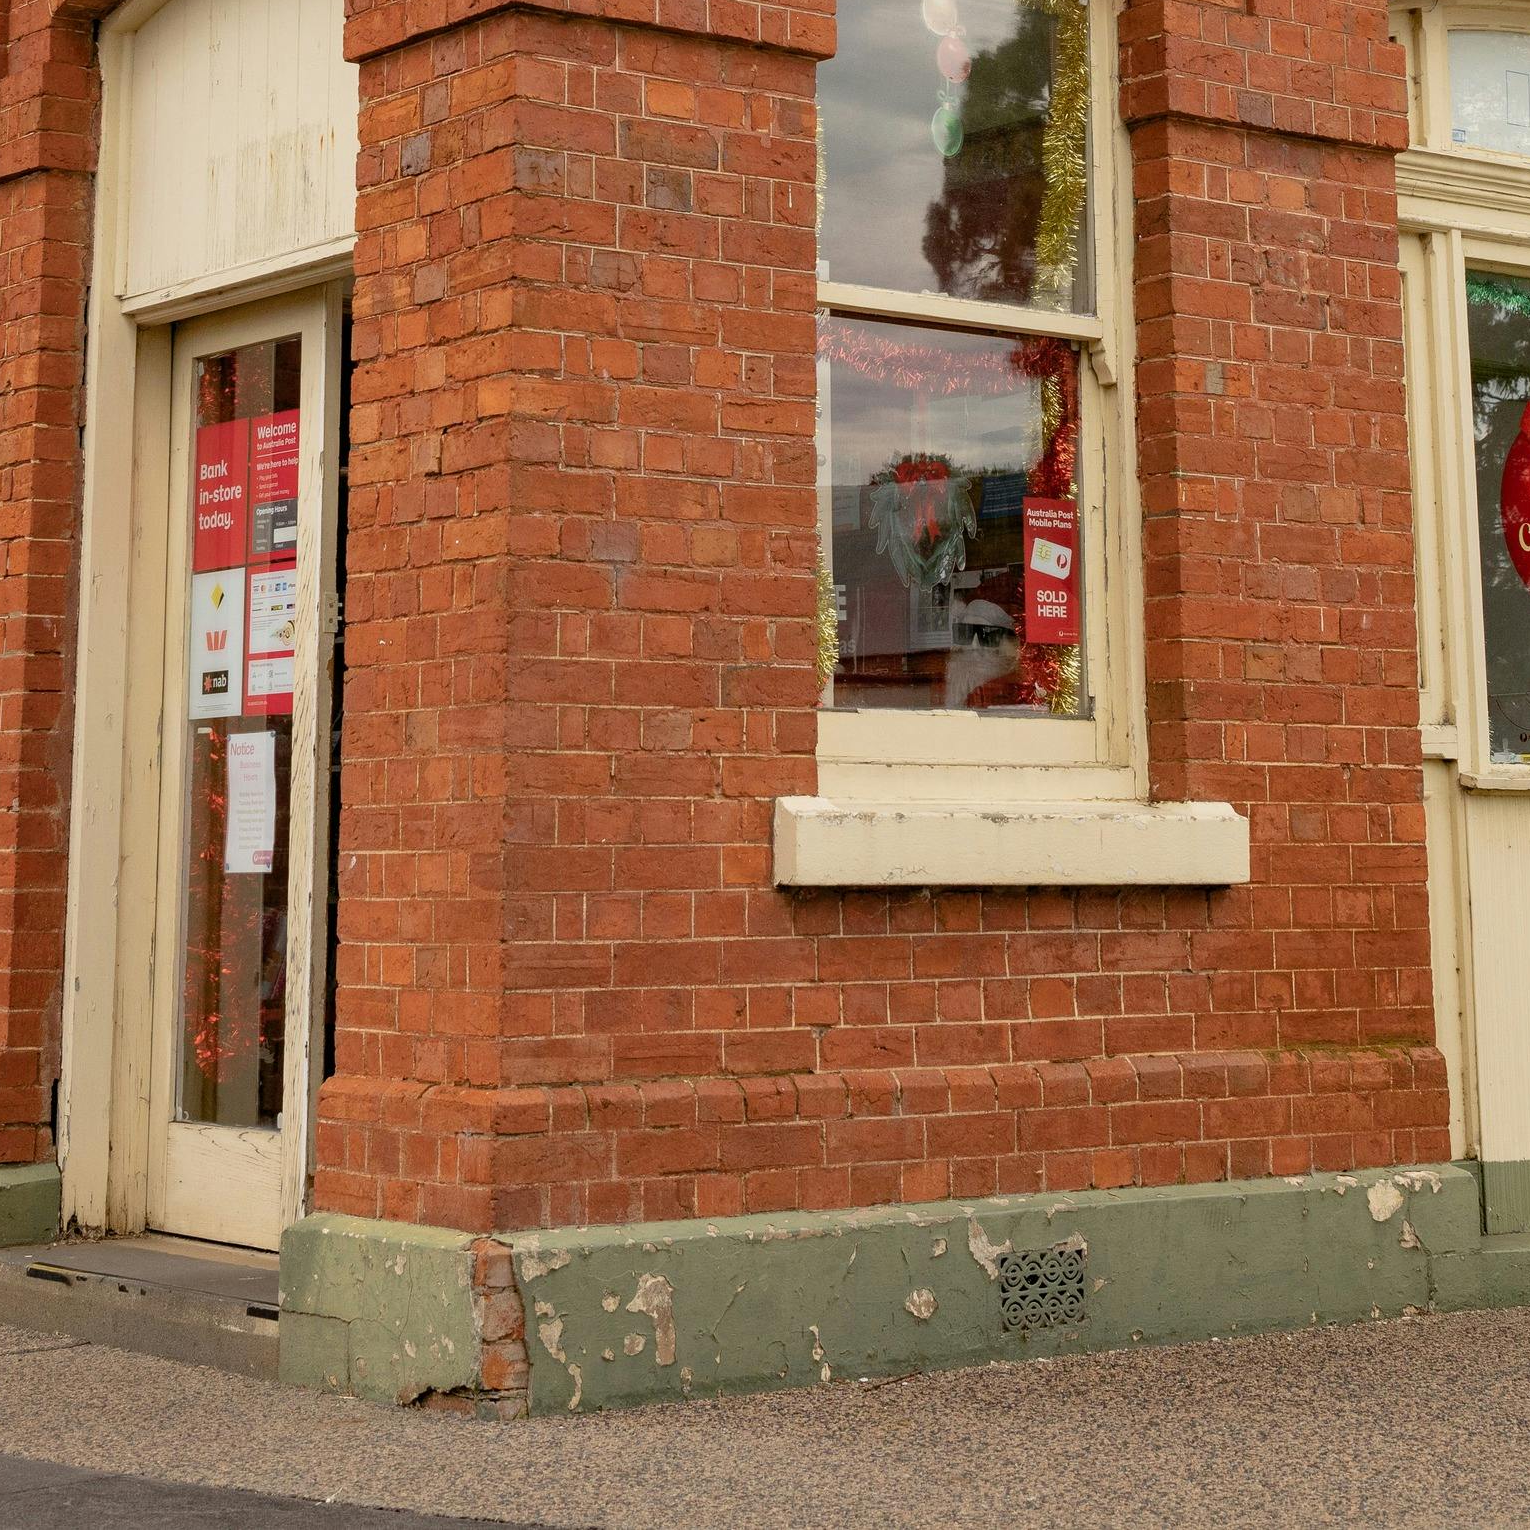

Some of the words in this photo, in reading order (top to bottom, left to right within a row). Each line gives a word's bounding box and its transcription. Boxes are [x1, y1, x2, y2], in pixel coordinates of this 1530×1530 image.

[257, 422, 297, 439] Welcome
[263, 438, 284, 449] Australia
[285, 436, 296, 446] Post
[270, 459, 281, 469] here
[288, 456, 299, 466] help
[200, 460, 228, 481] Bank
[199, 485, 242, 505] in-store
[256, 507, 274, 516] Opening
[1026, 508, 1057, 519] Australia
[1058, 510, 1074, 519] Post
[199, 510, 233, 530] today.
[1028, 518, 1053, 528] Mobile
[1053, 519, 1072, 529] Plans
[1036, 590, 1067, 604] SOLD
[1037, 605, 1067, 618] HERE
[212, 673, 227, 688] nab
[231, 741, 255, 756] Notice
